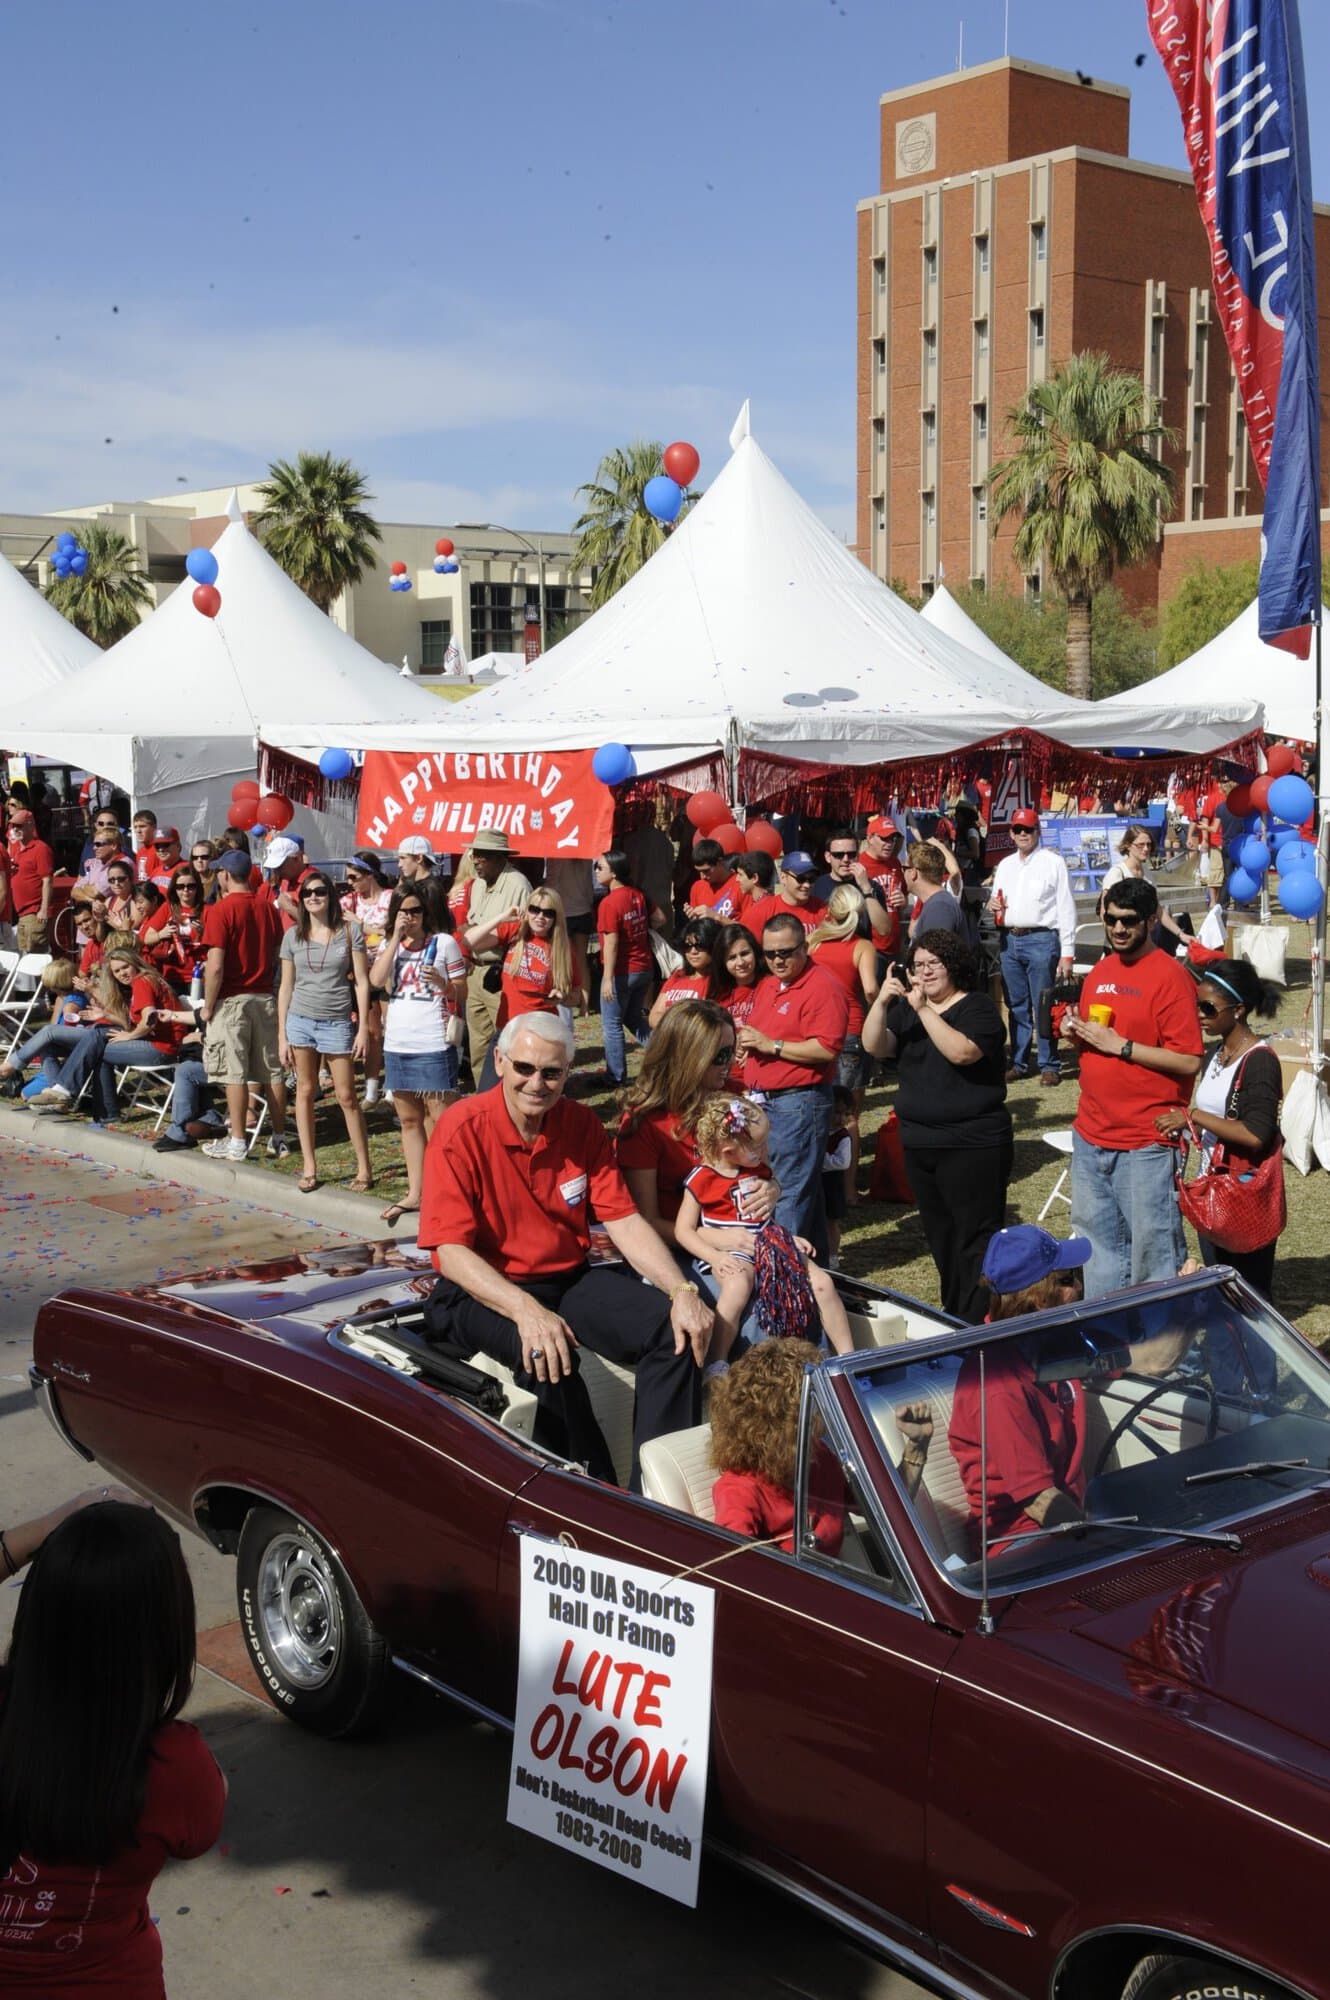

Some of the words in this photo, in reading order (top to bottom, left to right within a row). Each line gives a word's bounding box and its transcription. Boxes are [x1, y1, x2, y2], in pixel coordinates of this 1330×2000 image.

[366, 752, 447, 847] HAPPY
[454, 752, 579, 848] BIRTHDAY
[532, 1555, 585, 1593] 2009
[590, 1571, 618, 1604] UA
[622, 1579, 695, 1627] Sports
[548, 1592, 588, 1625] Hall
[593, 1606, 615, 1635] of
[618, 1614, 676, 1657] Fame
[243, 1588, 296, 1704] BFGoodrich
[552, 1639, 671, 1728] LUTE
[530, 1703, 688, 1814] OLSON
[516, 1765, 549, 1800] Men's
[550, 1781, 615, 1821] Basketball
[616, 1808, 649, 1843] Head
[650, 1822, 692, 1862] Coach
[555, 1811, 643, 1870] 1983-2008
